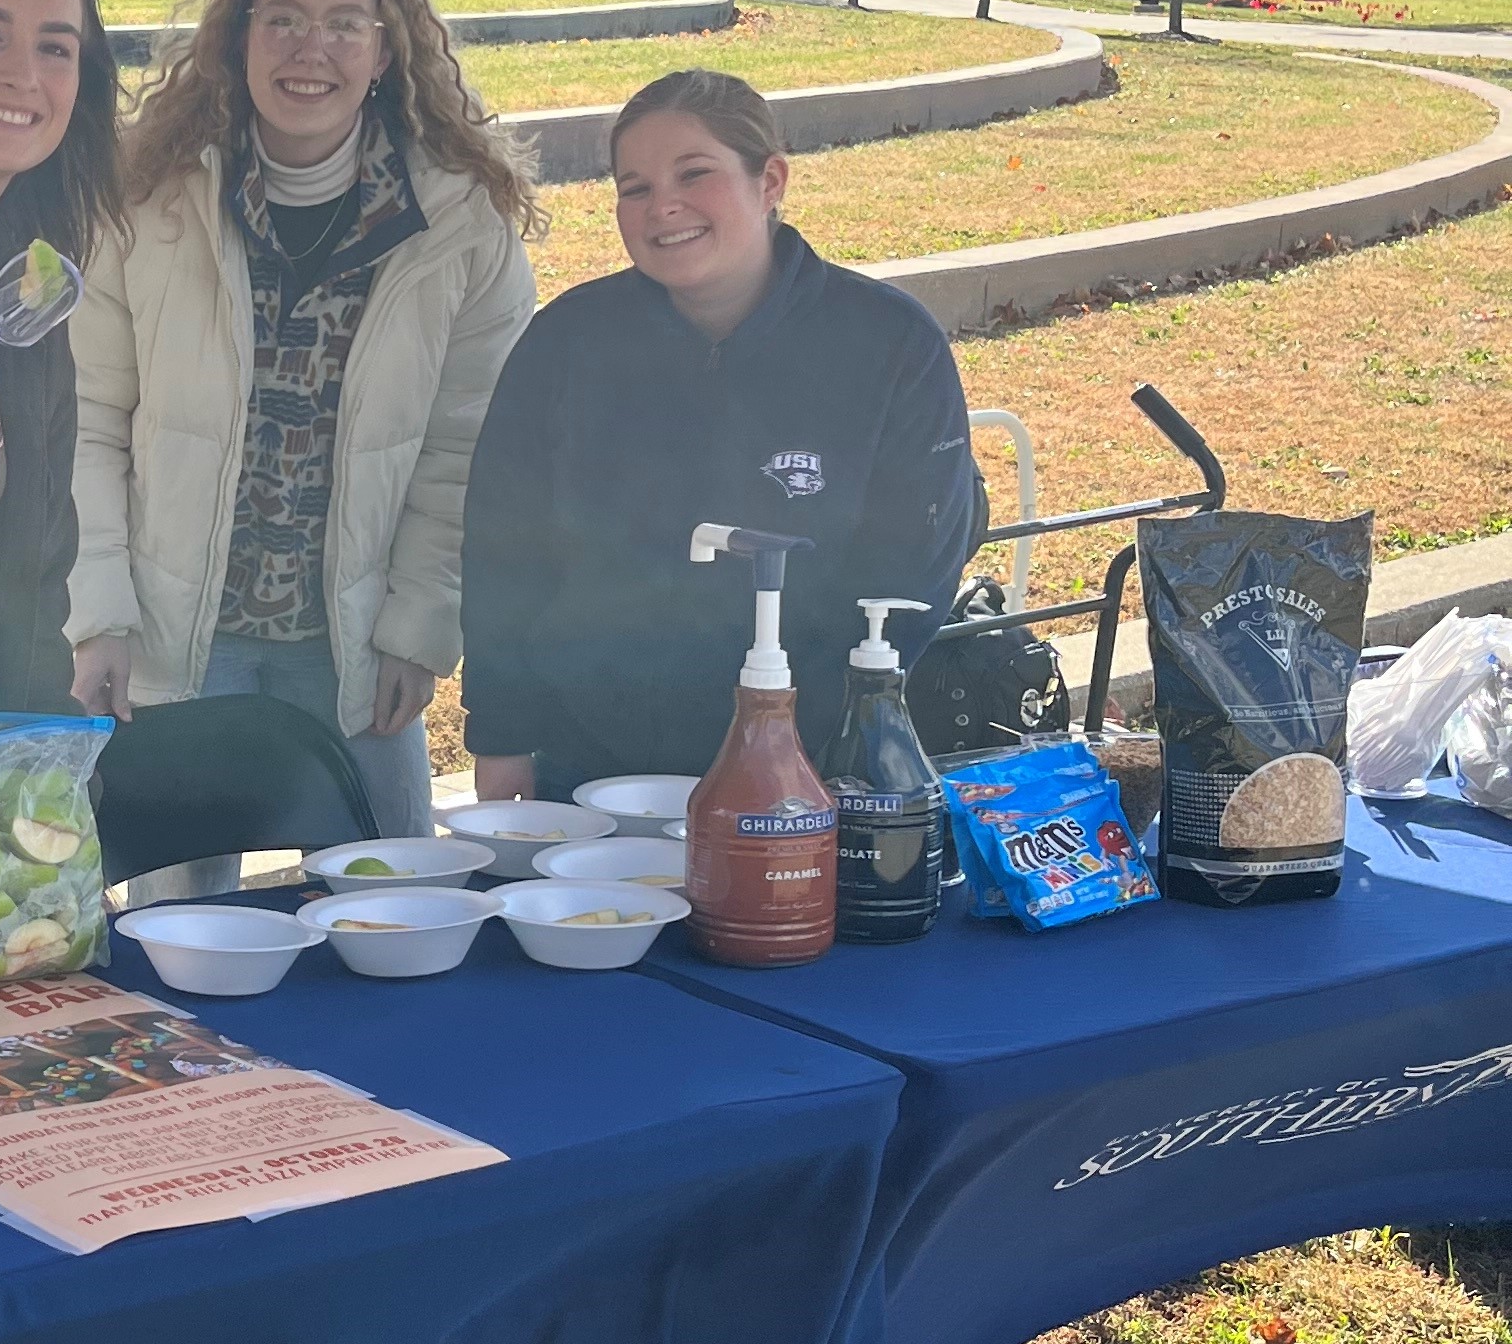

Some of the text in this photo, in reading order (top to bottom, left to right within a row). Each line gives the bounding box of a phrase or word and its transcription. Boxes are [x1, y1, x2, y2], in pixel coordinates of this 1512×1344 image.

[774, 453, 820, 472] USI
[1199, 583, 1327, 629] PRESTO SALES
[740, 810, 836, 834] GHIRARDELLI
[835, 797, 898, 812] ARDELLI
[764, 867, 823, 882] CARAMEL
[1242, 861, 1309, 874] GUARANTEED
[5, 984, 127, 1019] BAR
[37, 1084, 210, 1123] PRESENTED BY THE
[44, 1136, 97, 1153] YOUR
[96, 1129, 139, 1145] OWN
[139, 1112, 221, 1136] CARAMEL
[220, 1109, 245, 1121] OR
[245, 1092, 344, 1116] CHOCOLATE
[100, 1105, 185, 1129] STUDENT
[186, 1086, 272, 1111] ADVISORY
[1105, 1086, 1326, 1148] UNIVERSITY
[1336, 1076, 1389, 1093] OF
[16, 1168, 57, 1190] AND
[55, 1154, 117, 1176] LEARN
[116, 1144, 177, 1164] ABOUT
[178, 1136, 213, 1151] THE
[215, 1121, 297, 1143] POSITIVE
[296, 1109, 357, 1128] IMPACT
[73, 1142, 130, 1160] APPLE
[130, 1133, 177, 1152] WITH
[180, 1127, 217, 1142] NUT
[236, 1110, 293, 1127] CANDY
[101, 1147, 208, 1176] CHARITABLE
[211, 1138, 266, 1155] GIFTS
[264, 1133, 295, 1145] AT
[263, 1142, 373, 1169] OCTOBER
[77, 1202, 133, 1226] 11AM
[183, 1180, 238, 1199] RICE
[237, 1167, 307, 1189] PLAZA
[306, 1138, 458, 1175] AMPHITHEATRE
